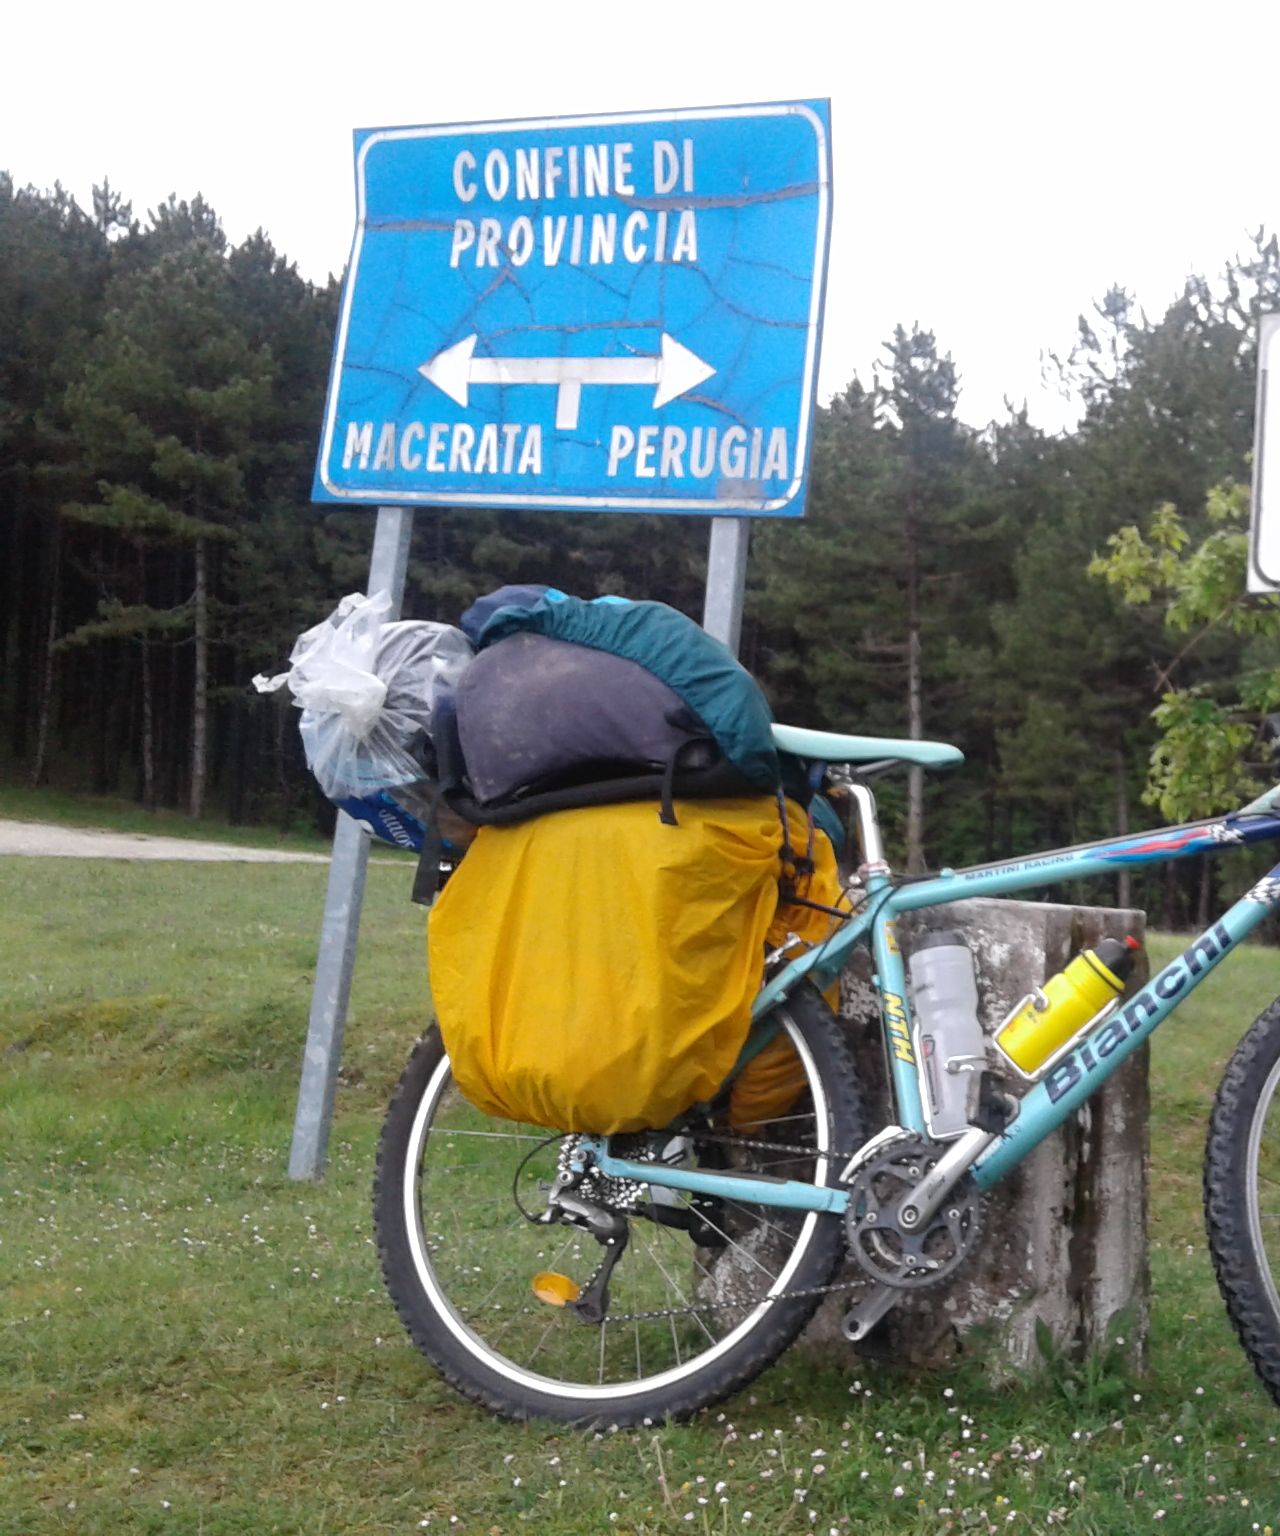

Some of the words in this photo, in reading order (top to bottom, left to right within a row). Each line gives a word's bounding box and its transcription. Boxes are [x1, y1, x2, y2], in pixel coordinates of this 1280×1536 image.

[453, 142, 636, 202] CONFINE
[653, 138, 695, 195] DI
[449, 210, 698, 268] PROVINCIA
[341, 421, 543, 475] MACERATA
[607, 424, 789, 480] PERUGIA
[1042, 920, 1233, 1105] Bianchi
